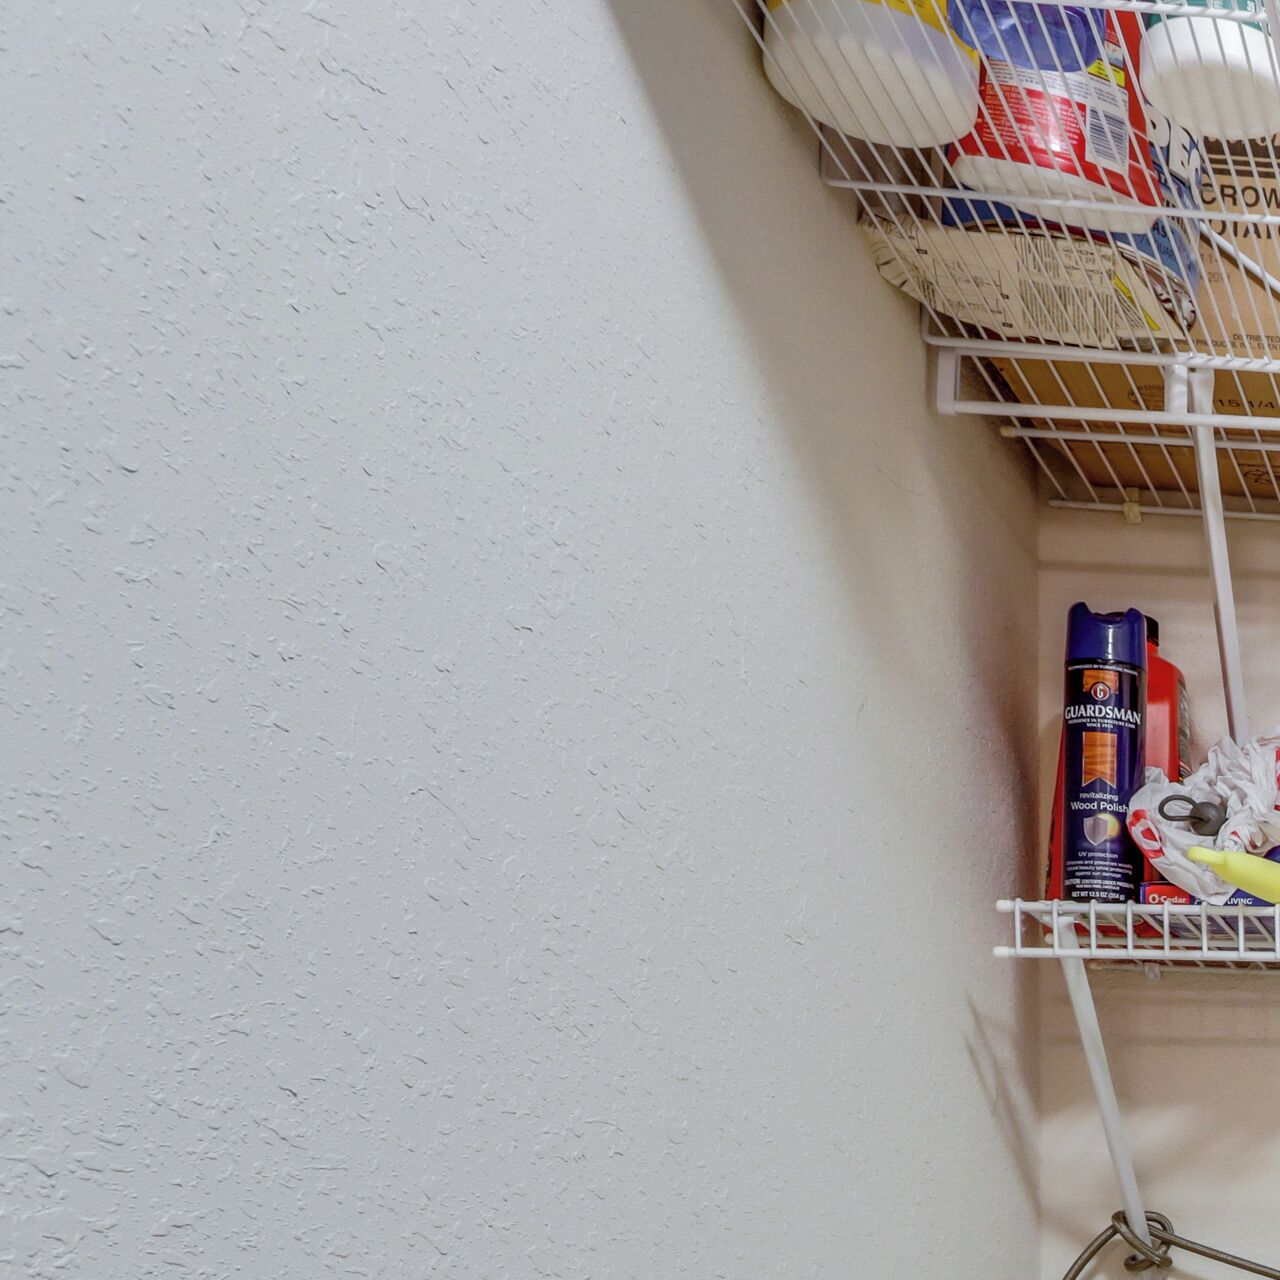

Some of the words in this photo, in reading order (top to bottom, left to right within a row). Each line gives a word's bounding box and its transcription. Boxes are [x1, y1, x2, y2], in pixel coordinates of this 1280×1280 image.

[1065, 703, 1141, 725] GUARDSMAN
[1079, 791, 1119, 802] revitalizing
[1070, 801, 1098, 811] Wood
[1100, 802, 1129, 813] Polish
[1149, 893, 1187, 904] O-Cedar
